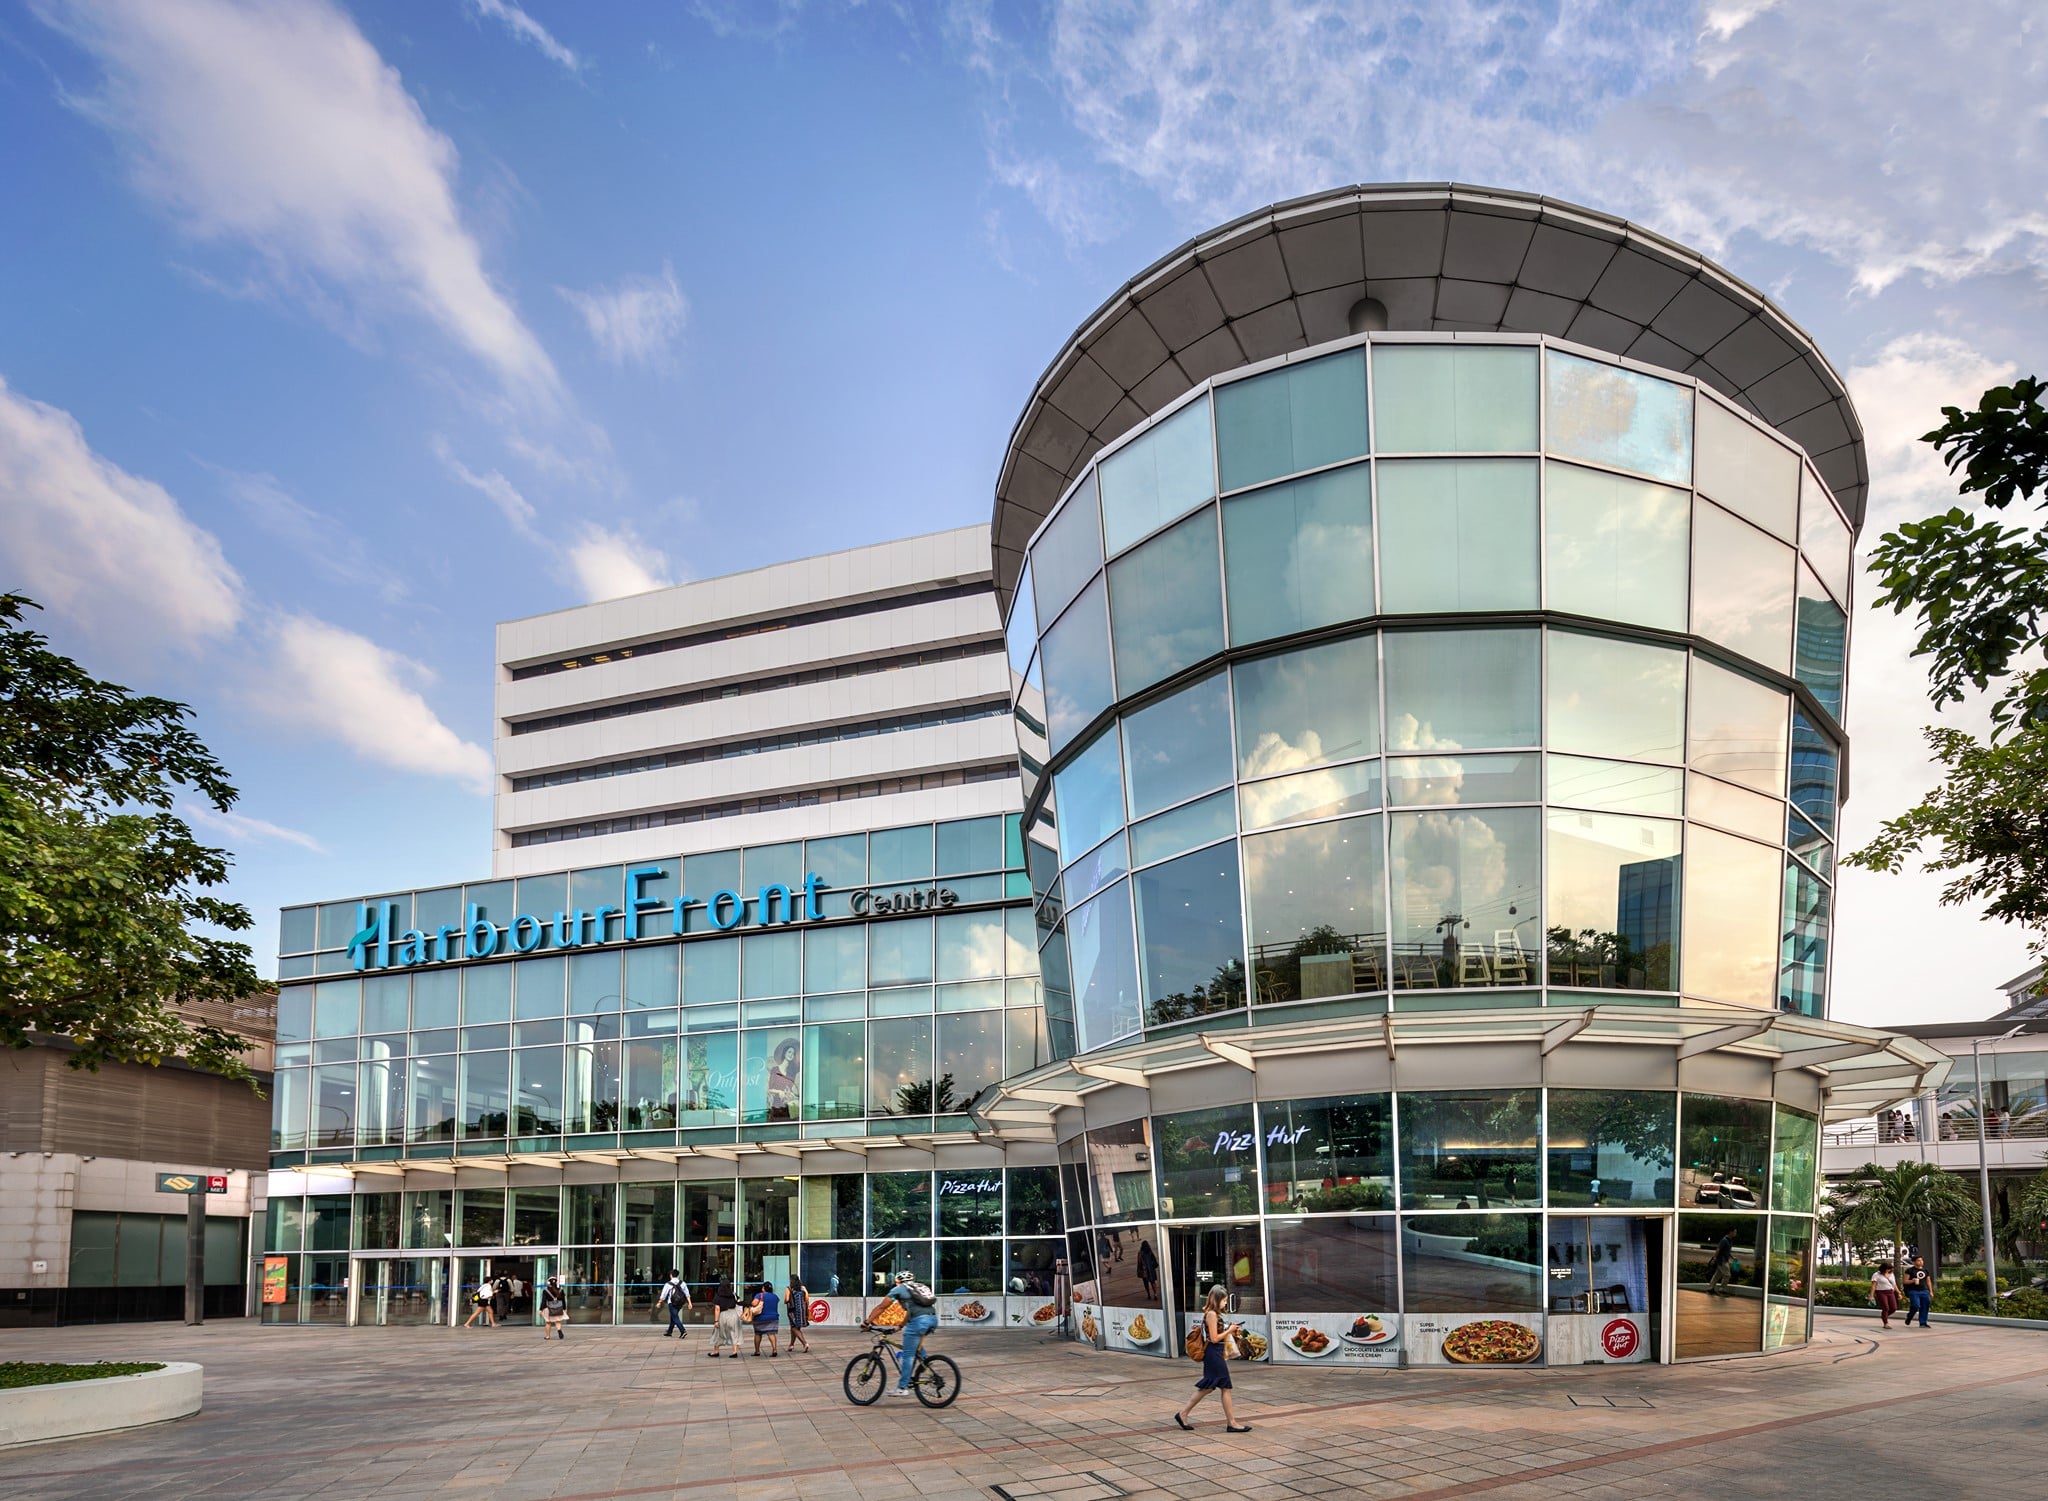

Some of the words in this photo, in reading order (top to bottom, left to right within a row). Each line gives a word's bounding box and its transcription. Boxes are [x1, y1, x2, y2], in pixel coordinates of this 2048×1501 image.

[347, 866, 827, 971] HarbourFront
[848, 885, 955, 916] Centre
[1266, 1125, 1311, 1147] Hut
[940, 1180, 976, 1195] Pizza
[976, 1179, 1004, 1193] Hut
[1608, 1334, 1631, 1346] Pizza
[1612, 1341, 1630, 1352] Hut
